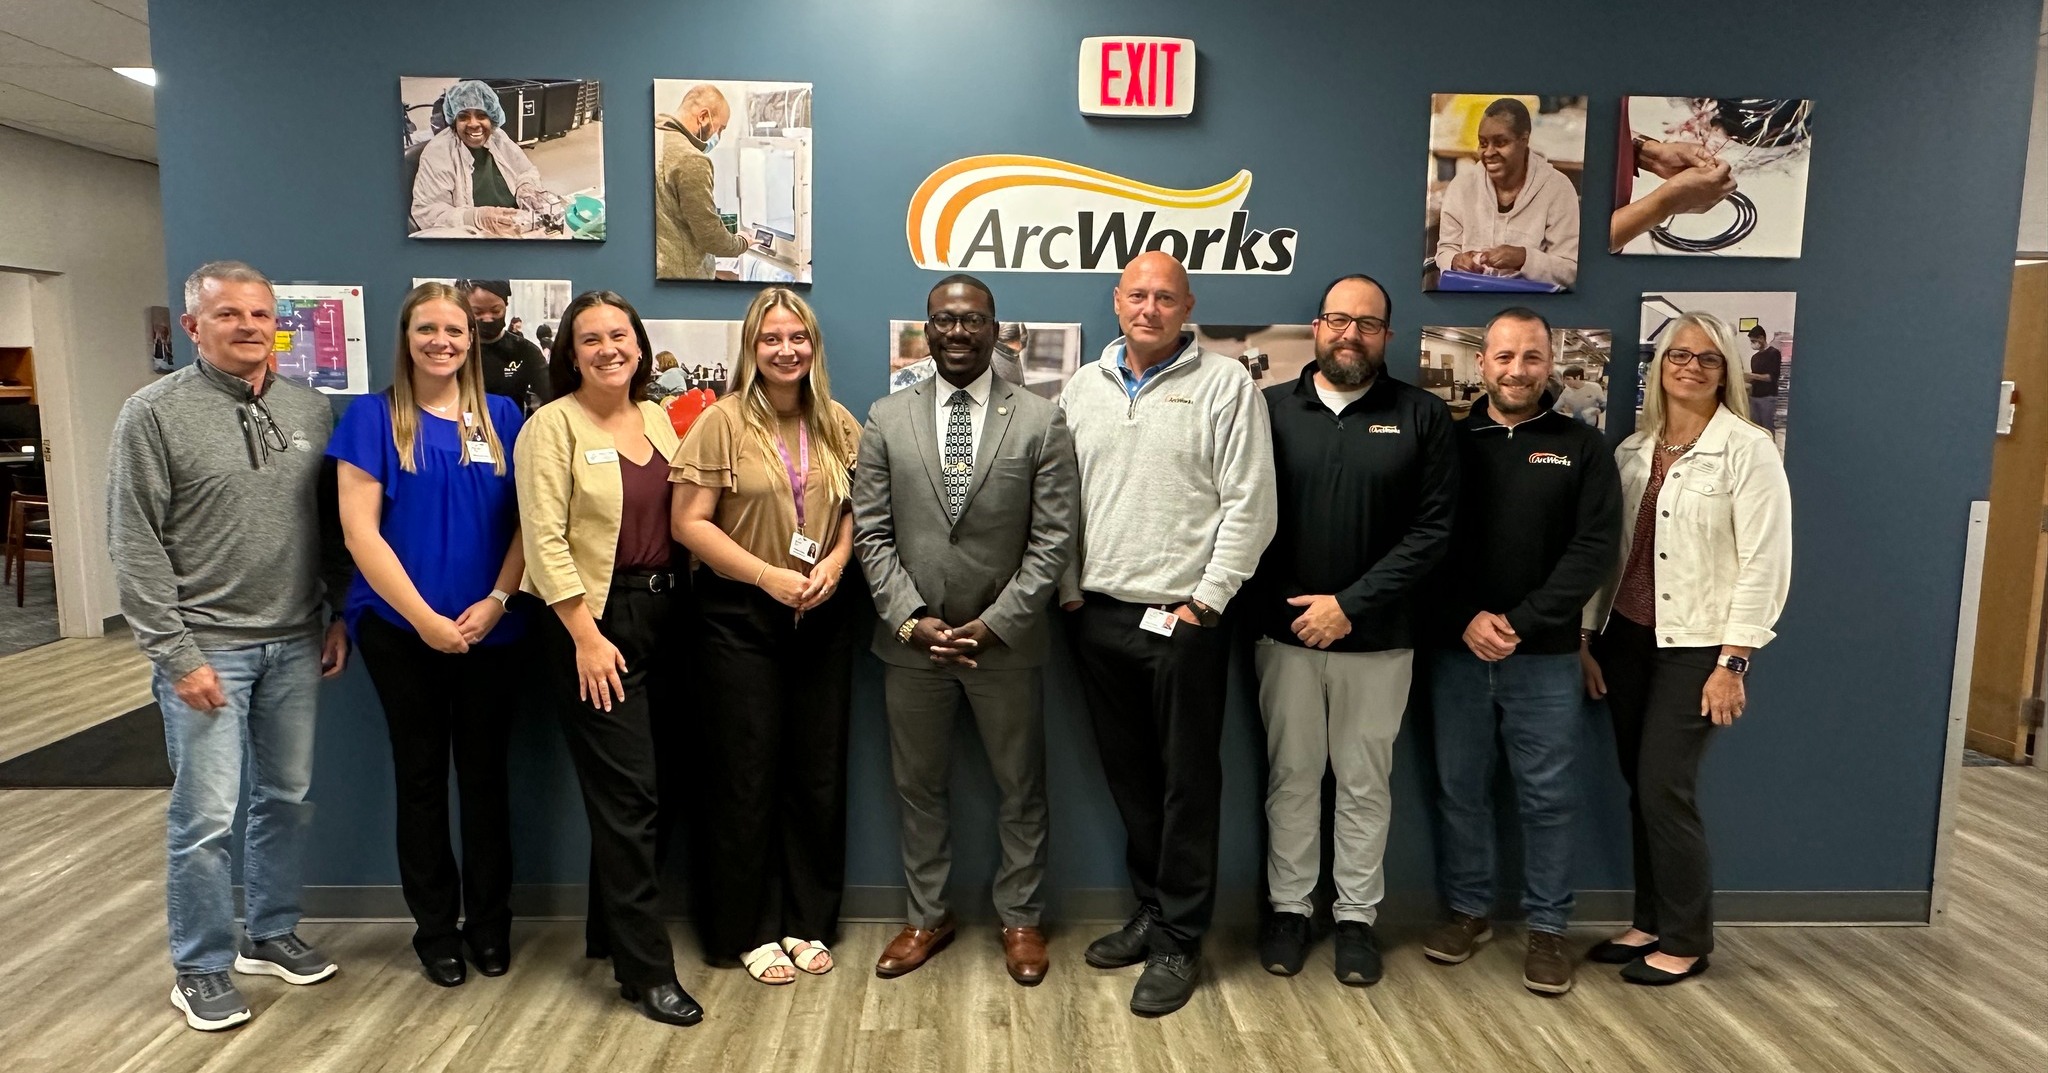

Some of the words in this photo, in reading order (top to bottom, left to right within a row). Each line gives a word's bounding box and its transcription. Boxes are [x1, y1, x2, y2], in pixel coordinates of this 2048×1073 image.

[1101, 42, 1181, 107] EXIT
[958, 208, 1297, 272] ArcWorks
[1534, 456, 1571, 466] ArcWorks
